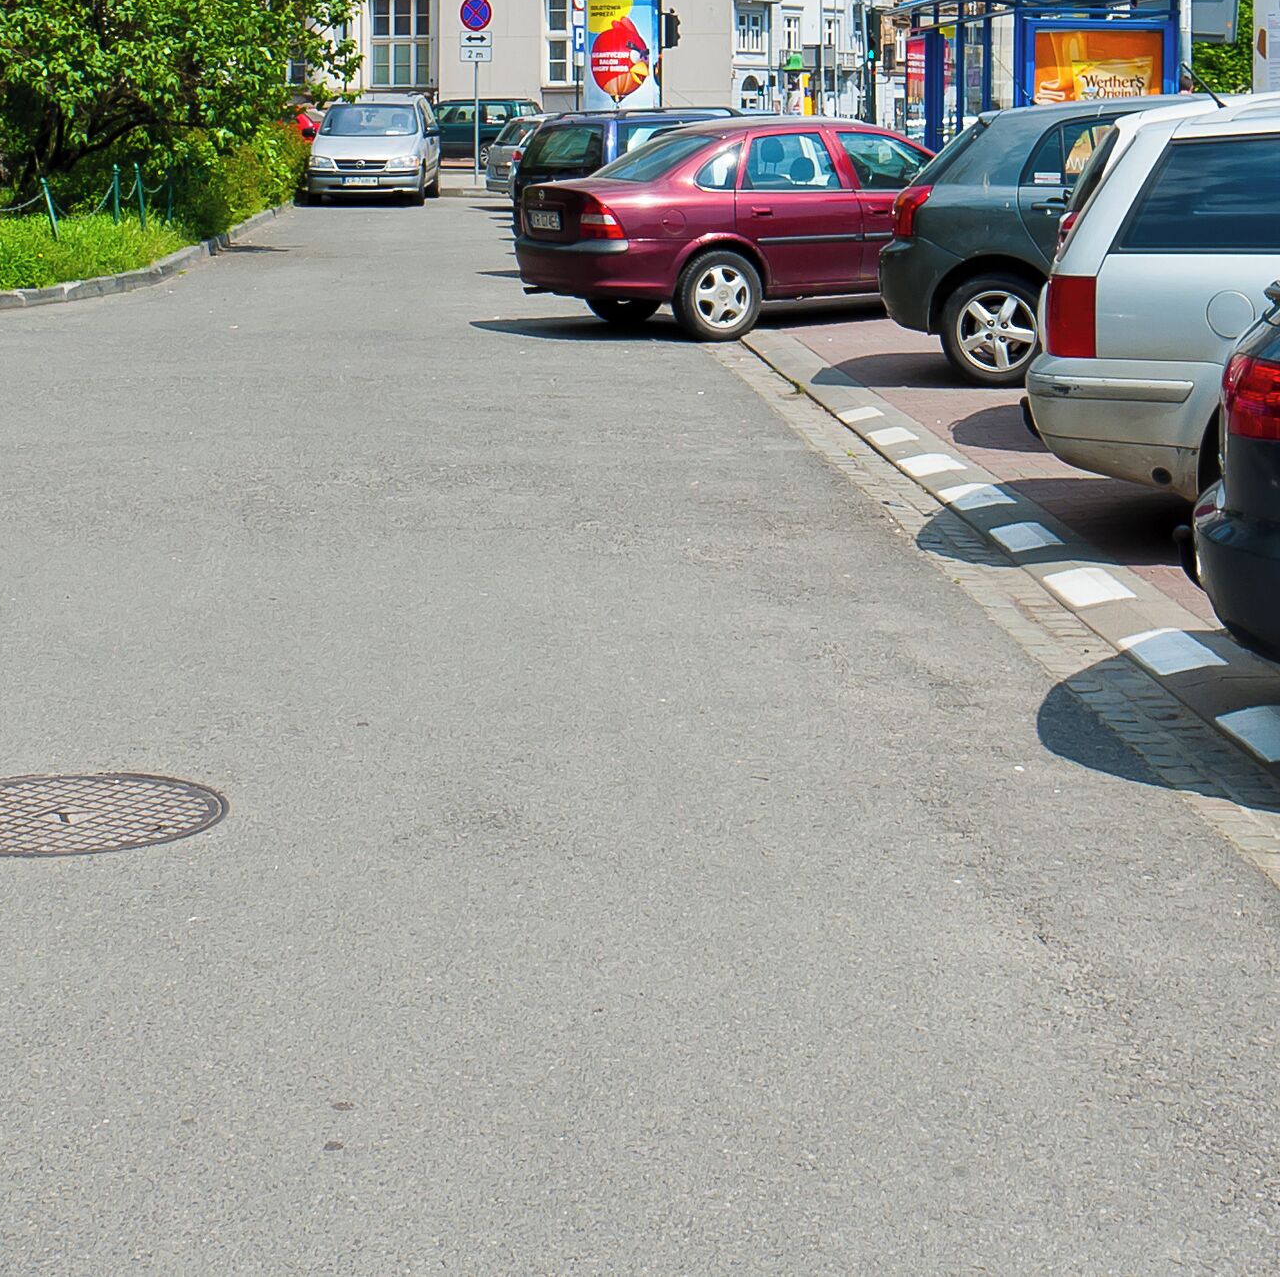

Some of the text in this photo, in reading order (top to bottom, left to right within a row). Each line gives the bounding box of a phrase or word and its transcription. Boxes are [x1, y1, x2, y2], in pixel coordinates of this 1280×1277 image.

[575, 28, 585, 50] P
[467, 49, 473, 58] 2
[1081, 74, 1145, 88] Werther's
